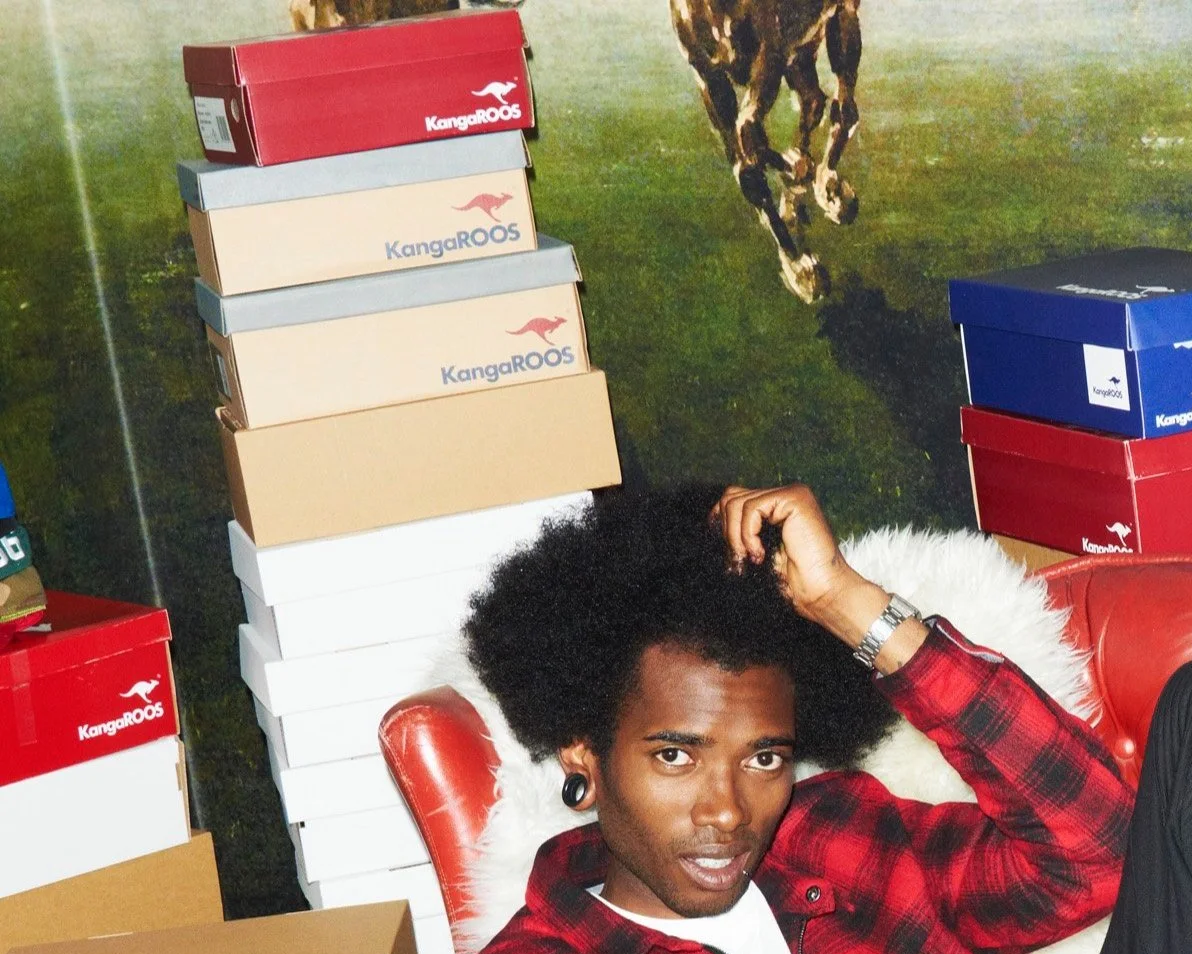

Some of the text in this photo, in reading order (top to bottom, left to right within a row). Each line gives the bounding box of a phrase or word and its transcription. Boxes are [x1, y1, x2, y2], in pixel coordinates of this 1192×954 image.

[425, 104, 522, 131] KangaROOS
[385, 223, 521, 259] KangaROOS
[441, 346, 574, 384] KangaROOS
[1093, 386, 1123, 399] KangaROOS
[78, 702, 164, 741] KangaROOS
